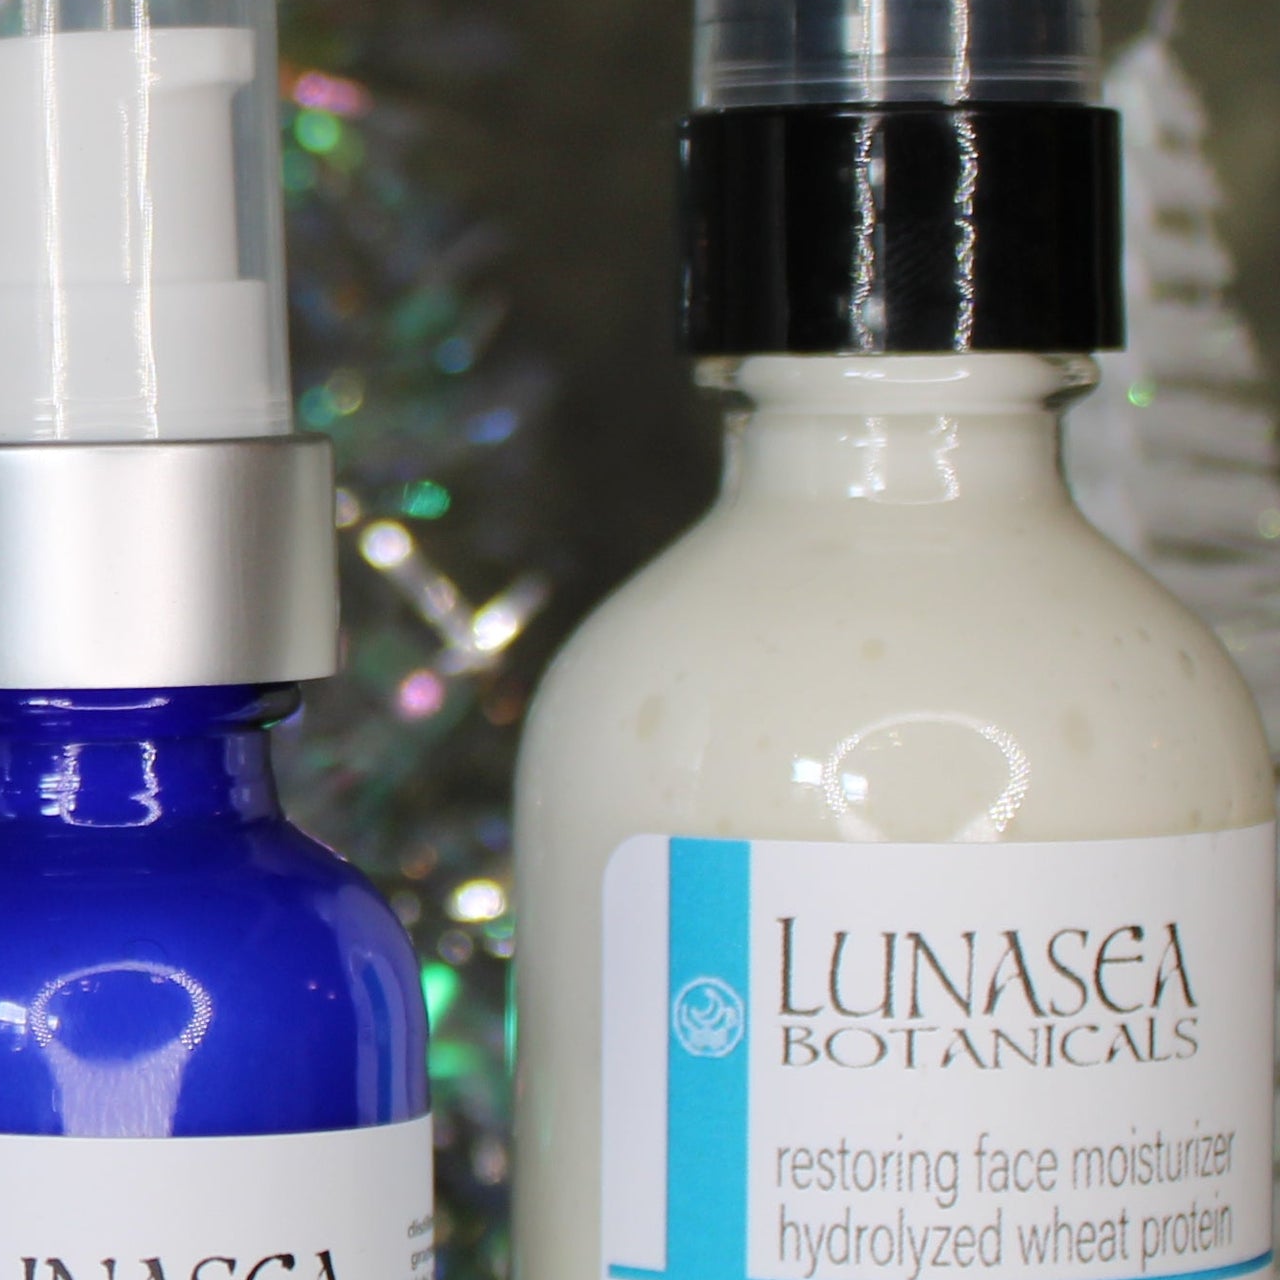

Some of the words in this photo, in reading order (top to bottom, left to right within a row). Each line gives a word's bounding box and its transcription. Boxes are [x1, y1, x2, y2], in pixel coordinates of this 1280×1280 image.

[776, 917, 1198, 1018] LUNASEA
[782, 1016, 1198, 1068] BOTANICALS
[777, 1132, 960, 1209] restoring
[974, 1132, 1058, 1193] face
[1072, 1120, 1235, 1189] moisturizer
[1018, 1206, 1129, 1265] wheat
[1140, 1191, 1233, 1272] protein
